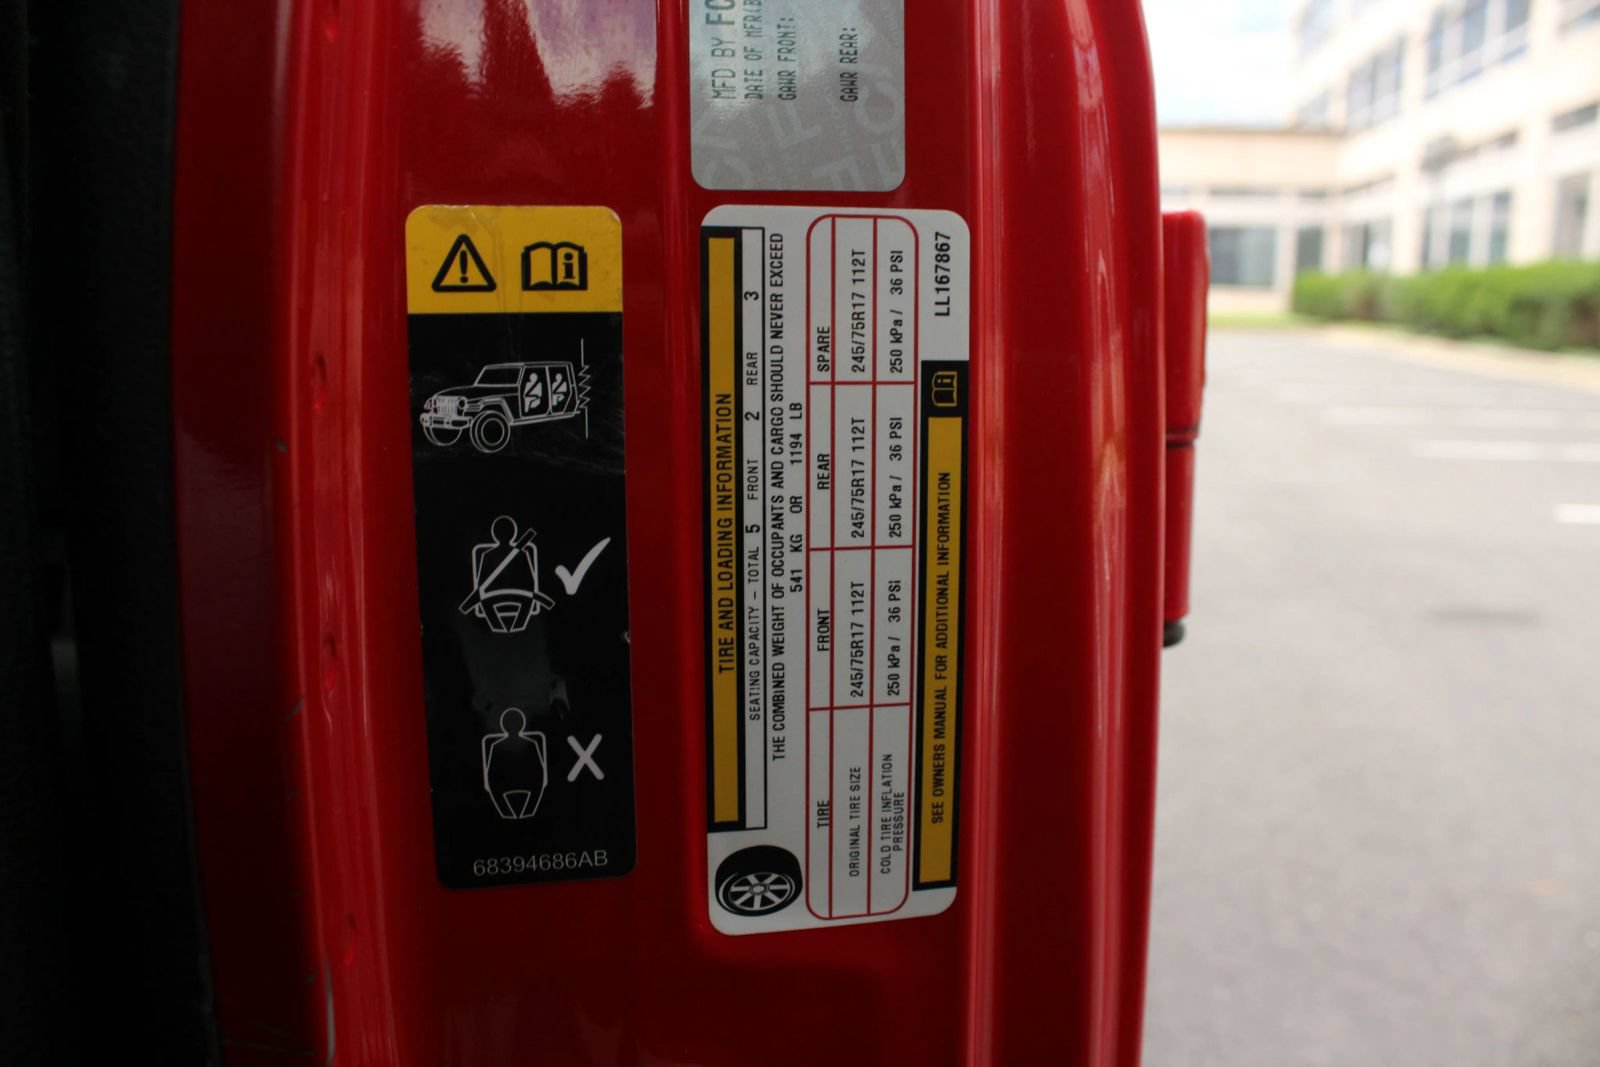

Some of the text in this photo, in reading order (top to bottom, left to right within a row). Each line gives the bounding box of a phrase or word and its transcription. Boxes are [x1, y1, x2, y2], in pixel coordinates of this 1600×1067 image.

[711, 36, 736, 58] BY
[744, 45, 763, 62] OF
[777, 17, 798, 101] GAWR FRONT:
[840, 27, 859, 102] GAWR REAR:
[711, 68, 737, 100] MFD
[744, 69, 765, 101] DATE
[890, 250, 904, 273] PSI
[935, 231, 951, 317] LL167867
[744, 290, 759, 302] 3
[890, 278, 903, 296] 36
[852, 249, 866, 373] 245/75R17 112T
[890, 319, 903, 344] kPa
[817, 325, 831, 373] SPARE
[890, 349, 903, 374] 250
[746, 352, 758, 386] REAR
[744, 411, 760, 421] 2
[890, 417, 903, 439] PSI
[890, 444, 903, 462] 36
[747, 459, 759, 501] FRONT
[817, 453, 831, 491] REAR
[851, 417, 865, 539] 245/75R17 112T
[770, 233, 786, 761] THE COMBINED WEIGHT OF OCCUPANTS AND CARGO SHOULD NEVER EXCEED
[790, 402, 803, 593] 541 KG OR 1194 LB
[889, 484, 902, 509] kPa
[716, 393, 735, 674] TIRE AND LOADING INFORMATION
[745, 524, 761, 534] 5
[889, 514, 902, 538] 250
[748, 546, 760, 584] TOTAL
[889, 580, 901, 602] PSI
[817, 608, 831, 652] FRONT
[888, 606, 901, 623] 36
[749, 606, 760, 666] CAPACITY
[850, 581, 865, 698] 245/75R17 112T
[931, 472, 951, 825] SEE OWNERS MANUAL FOR ADDITIONAL INFORMATION
[888, 645, 901, 669] kPa
[749, 670, 761, 721] SEATING
[888, 673, 900, 697] 250
[817, 799, 830, 829] TIRE
[849, 767, 861, 877] ORIGINAL TIRE SIZE
[880, 753, 893, 875] COLD TIRE INFLATION
[892, 791, 904, 852] PRESSURE
[473, 849, 608, 876] 68394686AB
